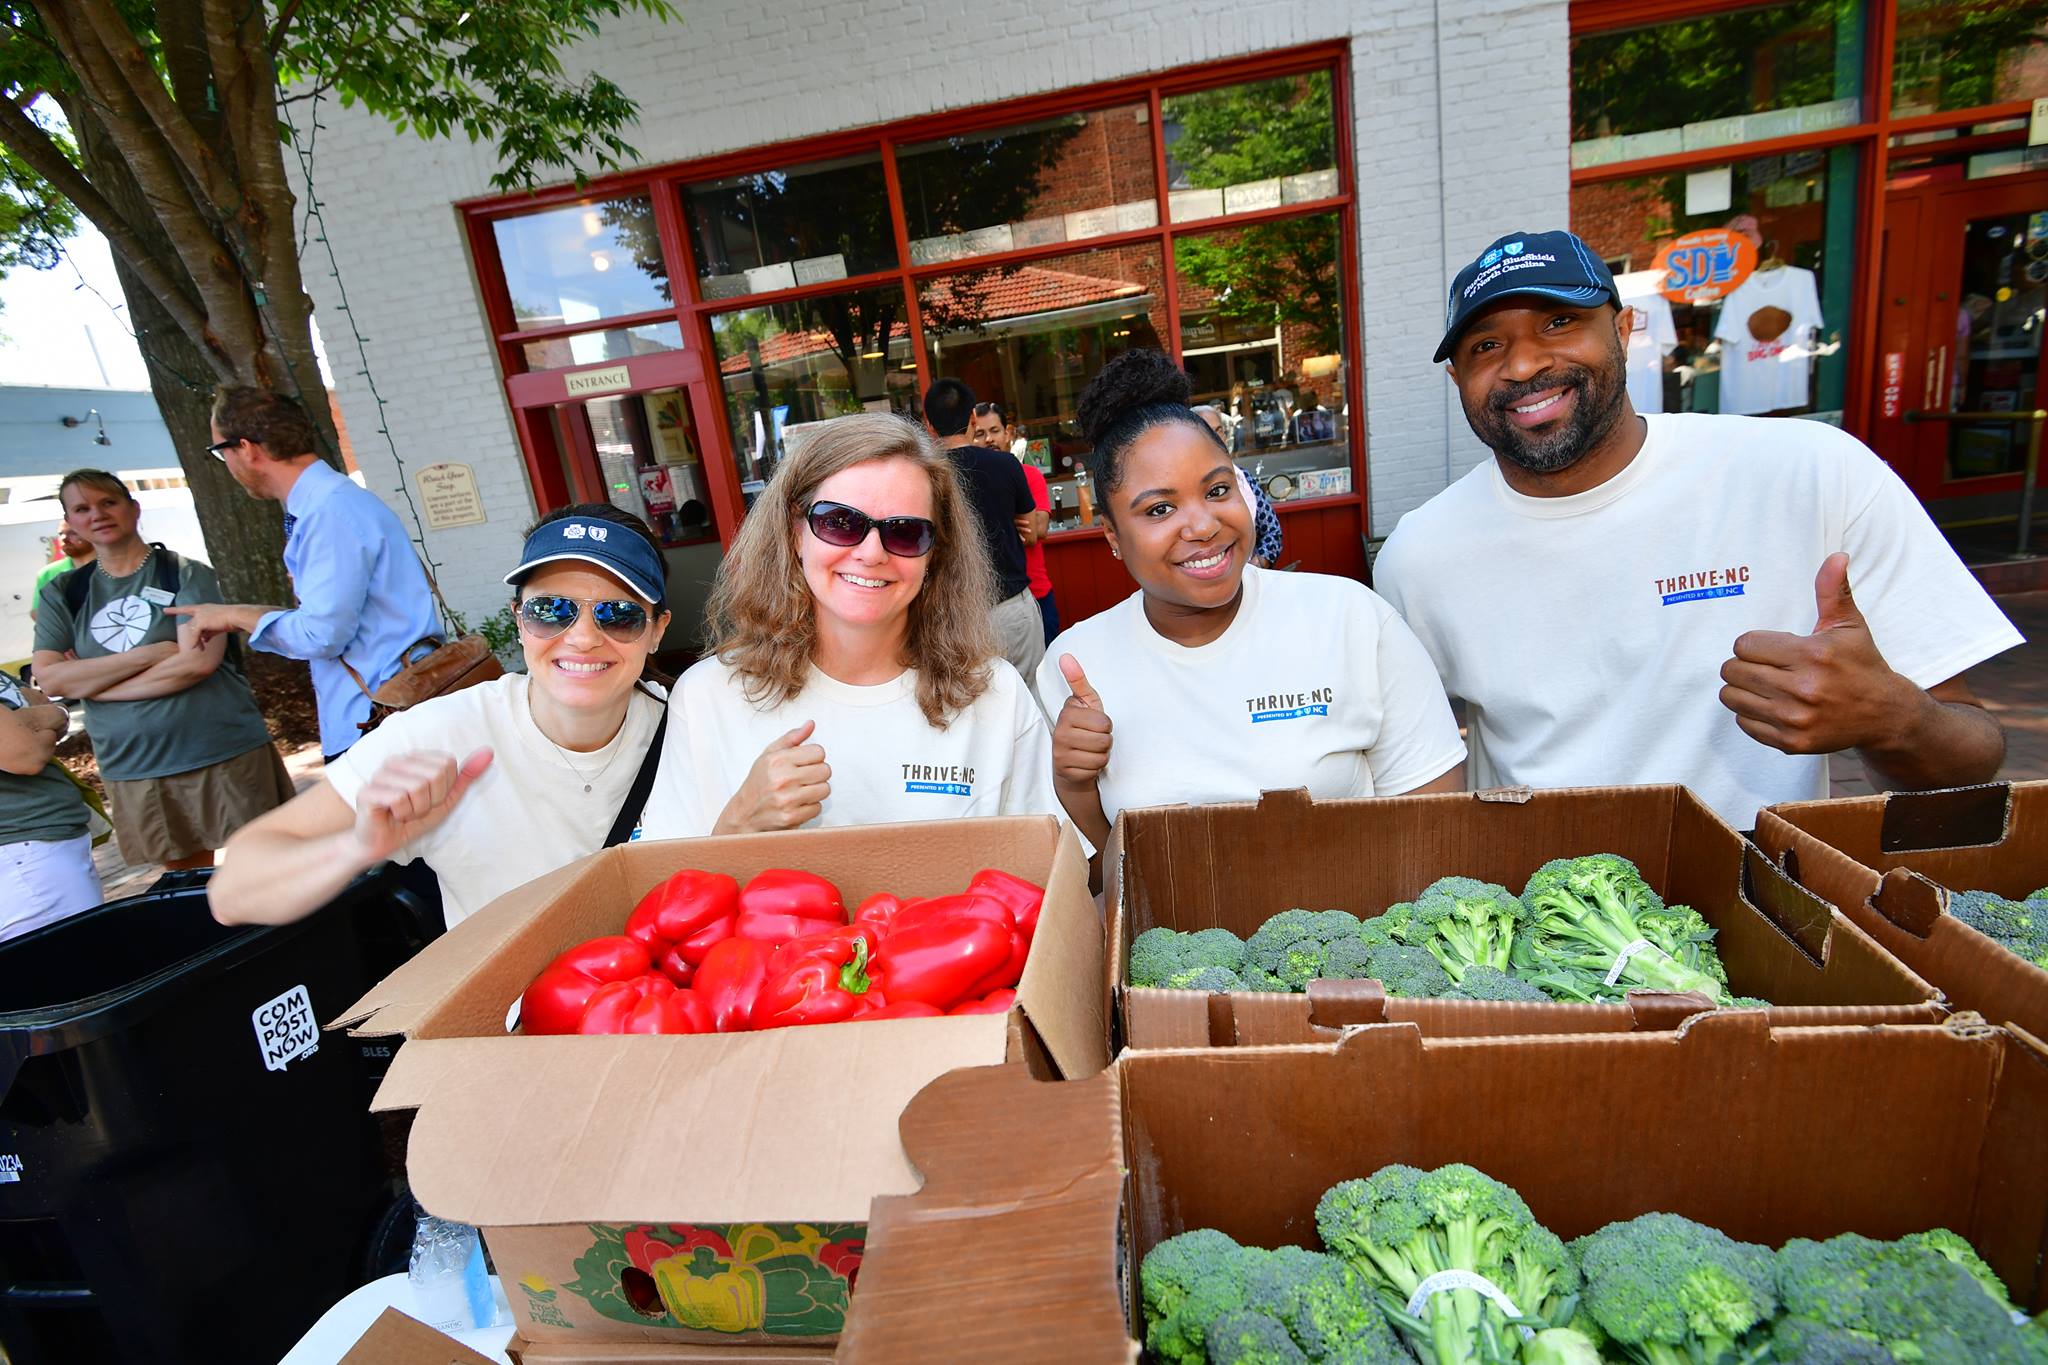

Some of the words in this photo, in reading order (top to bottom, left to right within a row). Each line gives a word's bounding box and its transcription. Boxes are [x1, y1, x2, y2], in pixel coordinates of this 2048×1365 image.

[1502, 253, 1556, 267] BlueShield
[1477, 269, 1502, 290] North
[1502, 261, 1546, 273] Carolina
[569, 372, 626, 391] ENTRANCE
[263, 1008, 308, 1046] POST
[268, 1025, 313, 1064] NOW
